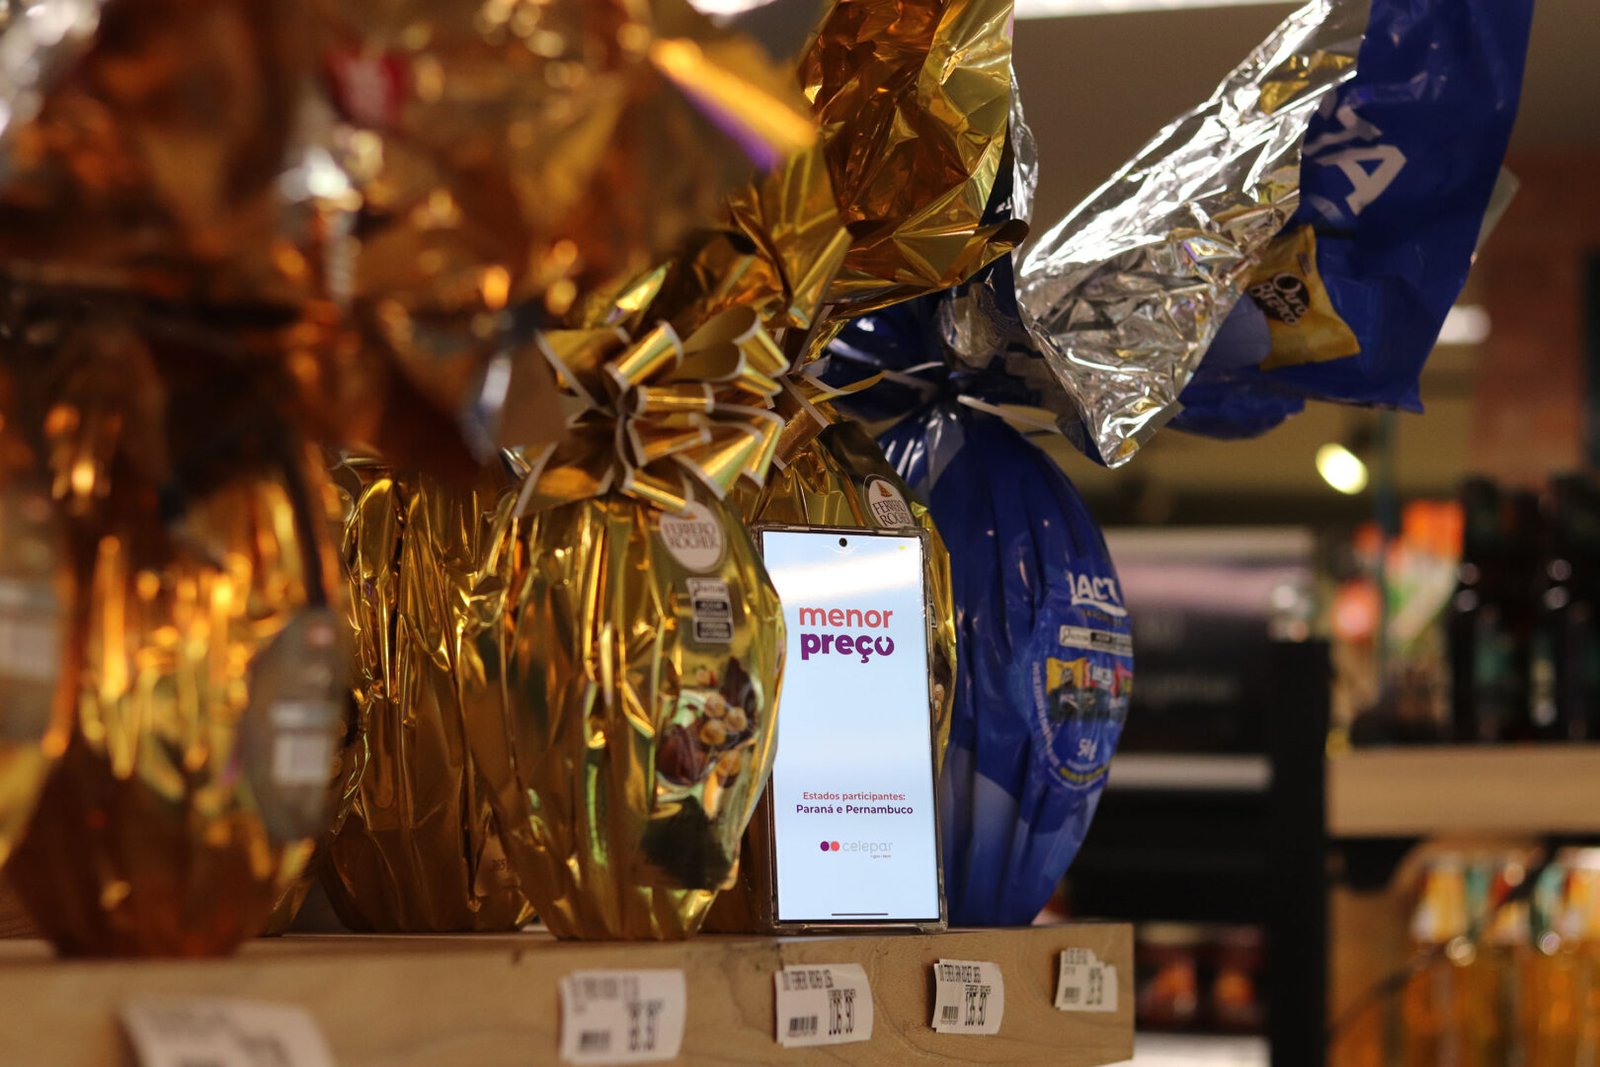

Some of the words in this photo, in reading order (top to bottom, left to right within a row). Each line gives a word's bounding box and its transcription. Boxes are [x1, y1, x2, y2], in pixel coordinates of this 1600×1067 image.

[799, 607, 894, 629] menor
[800, 633, 895, 664] preço
[803, 791, 840, 801] Estados
[842, 791, 906, 802] participantes:
[796, 804, 834, 814] Paraná
[836, 806, 843, 814] e
[845, 804, 914, 815] Pernambuco
[842, 840, 894, 853] celepar
